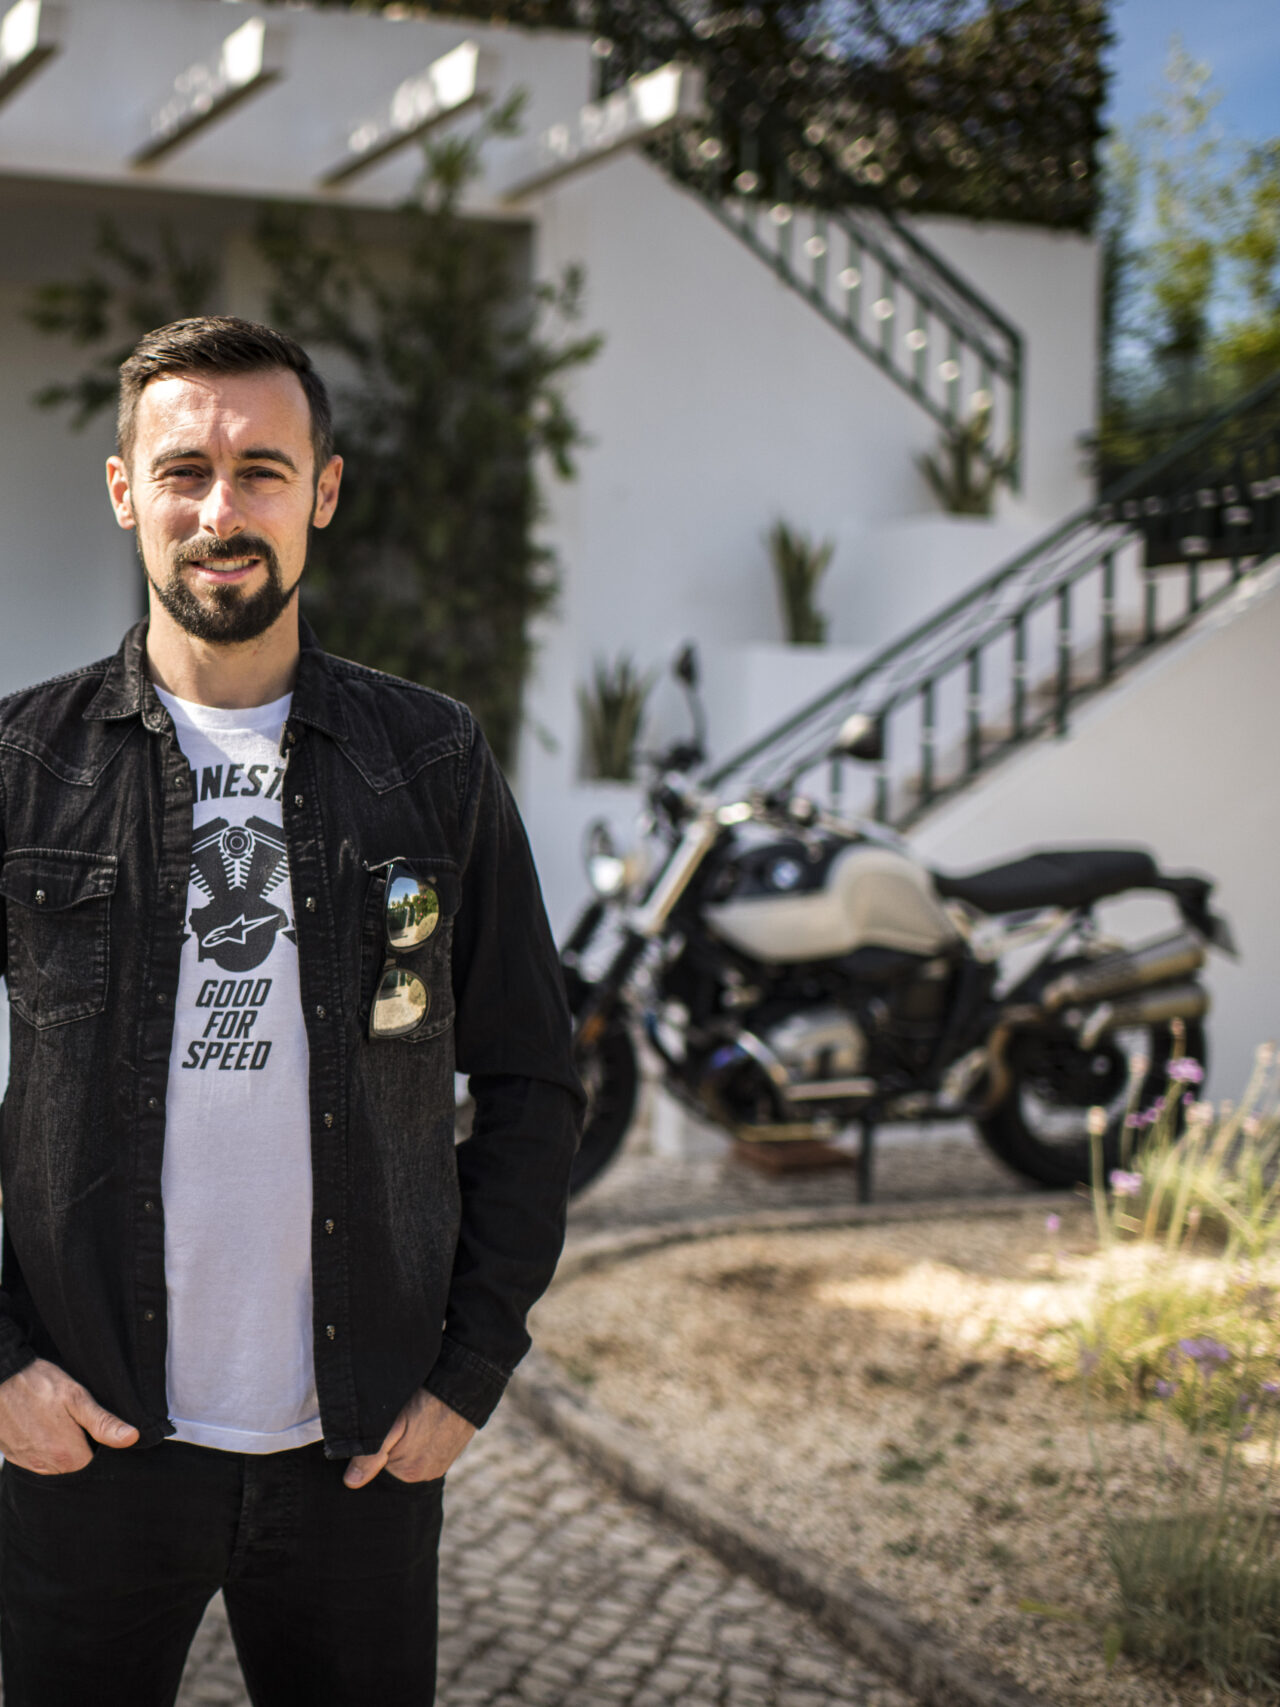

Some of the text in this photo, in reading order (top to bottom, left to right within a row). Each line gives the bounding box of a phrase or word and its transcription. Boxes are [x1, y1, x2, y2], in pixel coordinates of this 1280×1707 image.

[191, 763, 285, 803] NEST
[195, 978, 272, 1008] GOOD
[202, 1010, 258, 1039] FOR
[182, 1041, 272, 1070] SPEED
